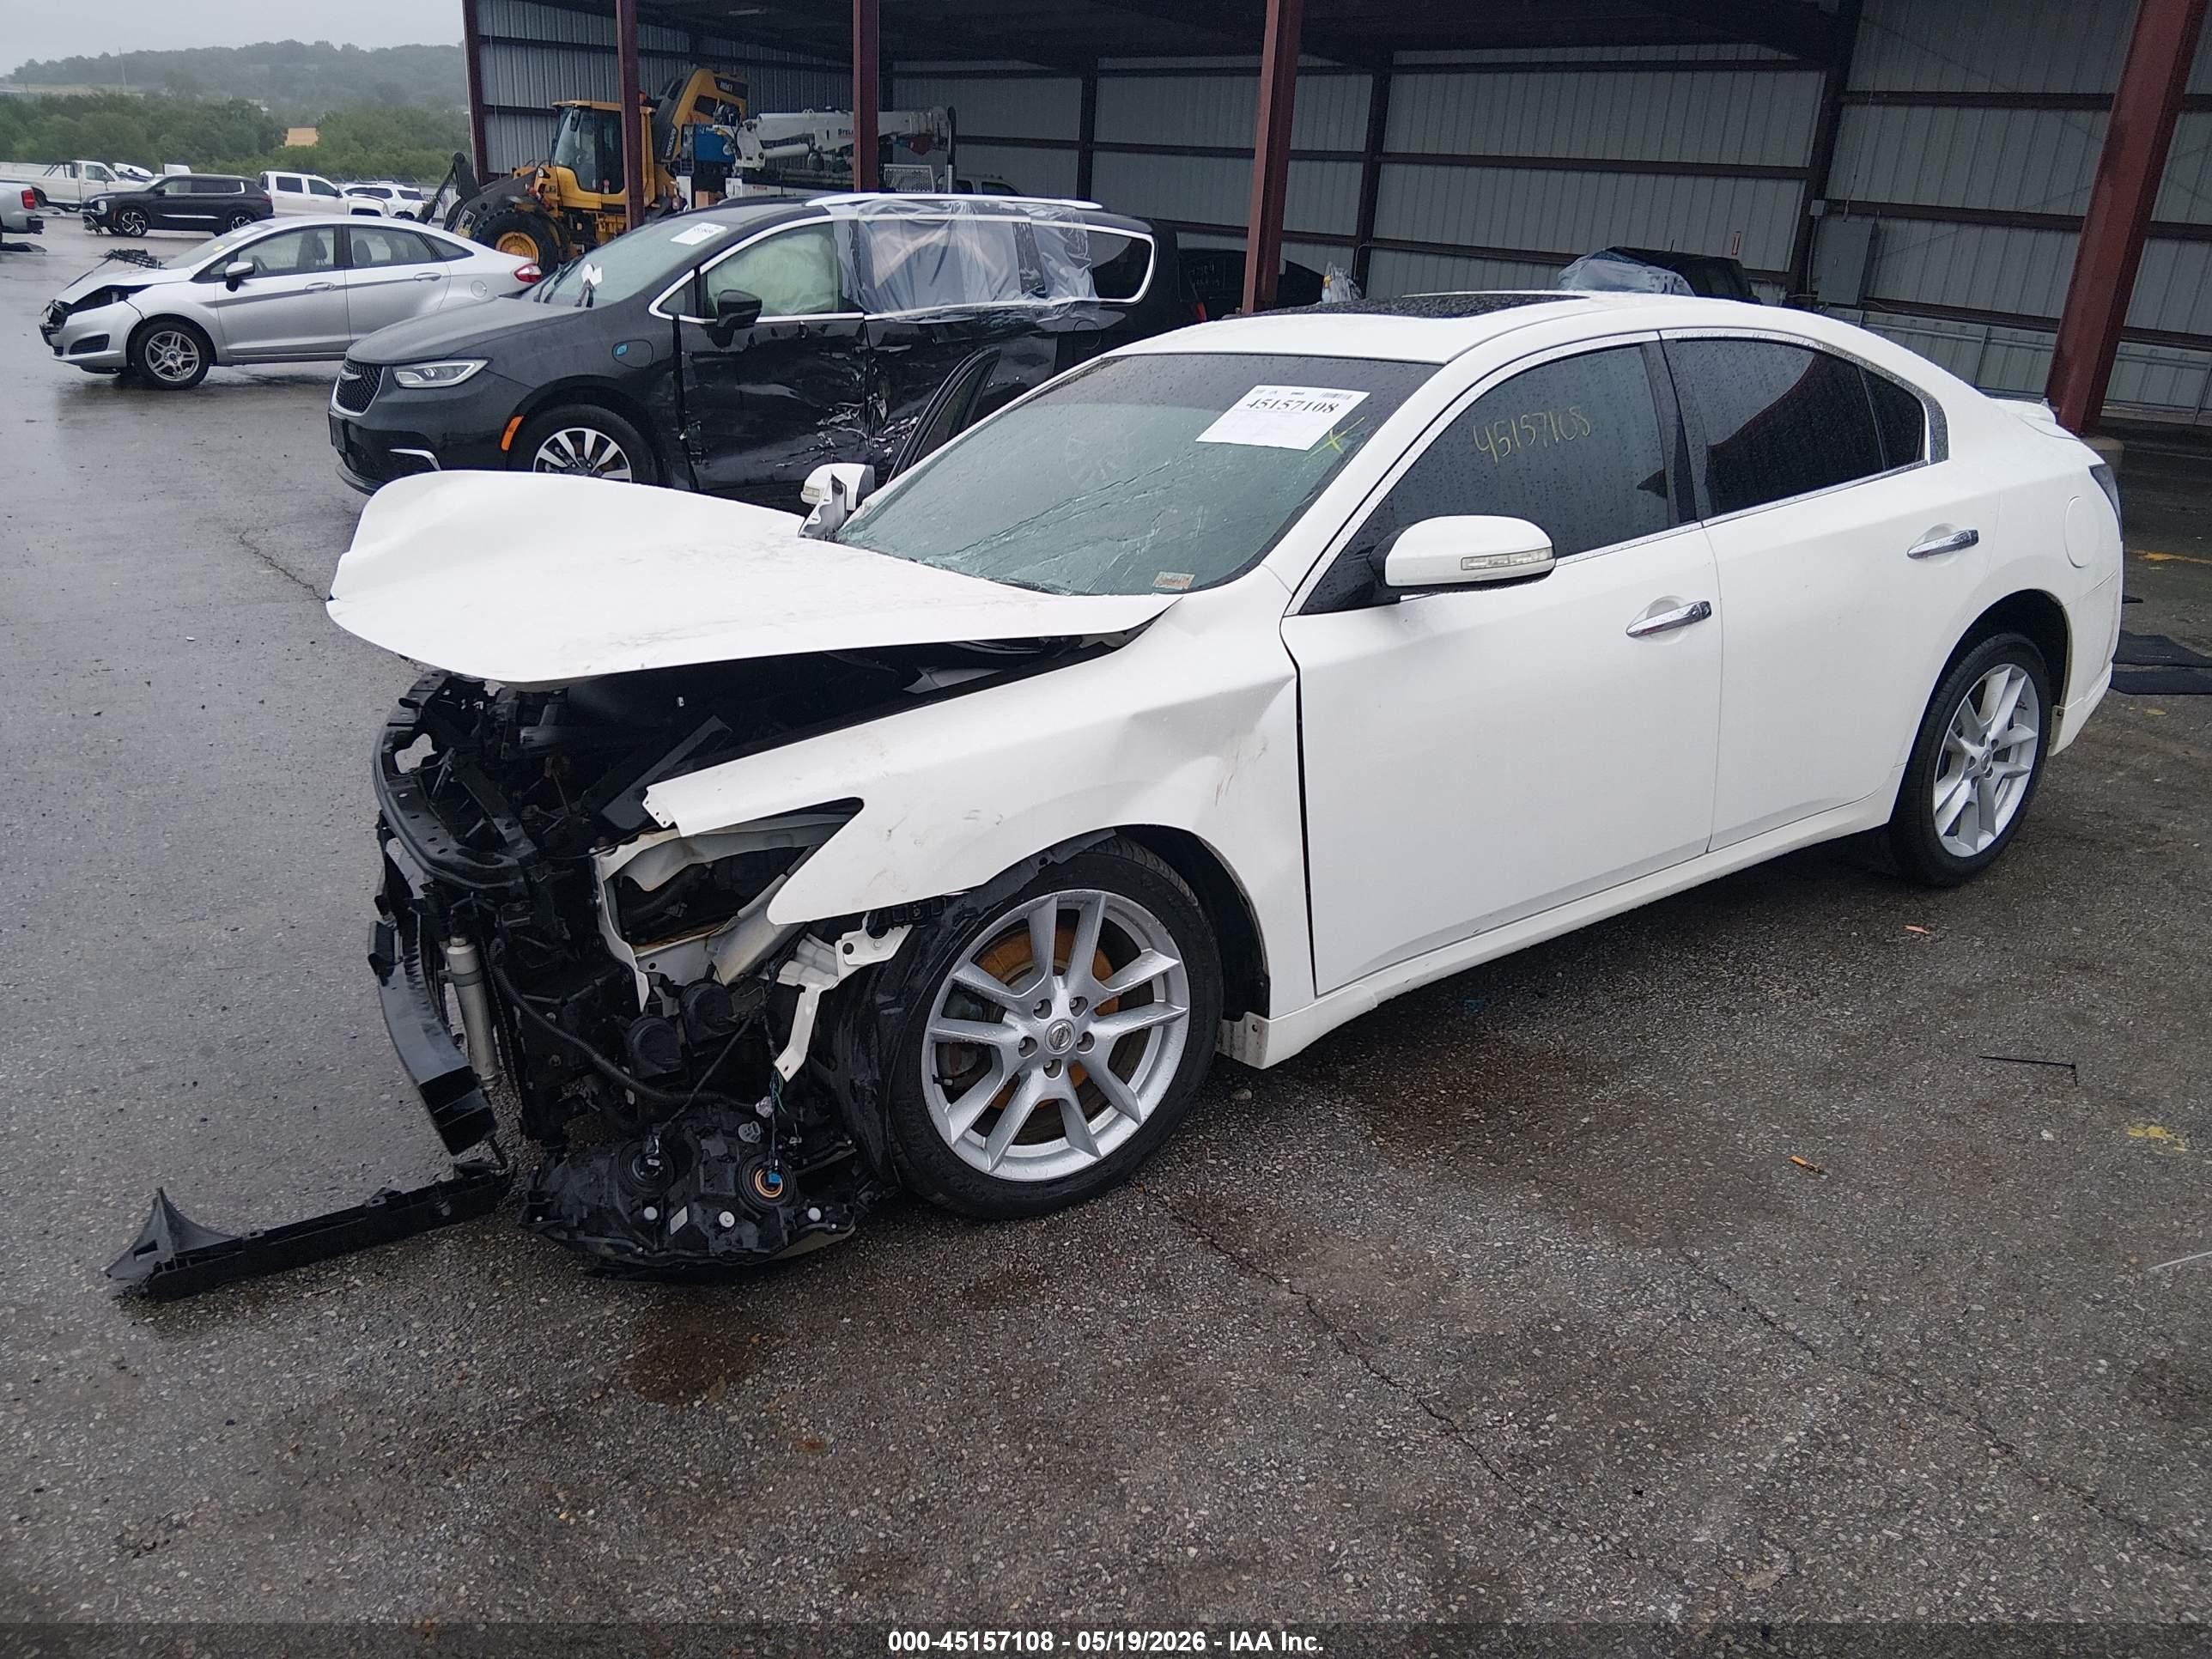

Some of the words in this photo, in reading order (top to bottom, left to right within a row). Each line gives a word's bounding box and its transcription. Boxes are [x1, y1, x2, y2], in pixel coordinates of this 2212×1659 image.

[665, 127, 678, 158] VOLVO
[1246, 398, 1340, 413] 45157108
[1473, 405, 1590, 464] 45157108
